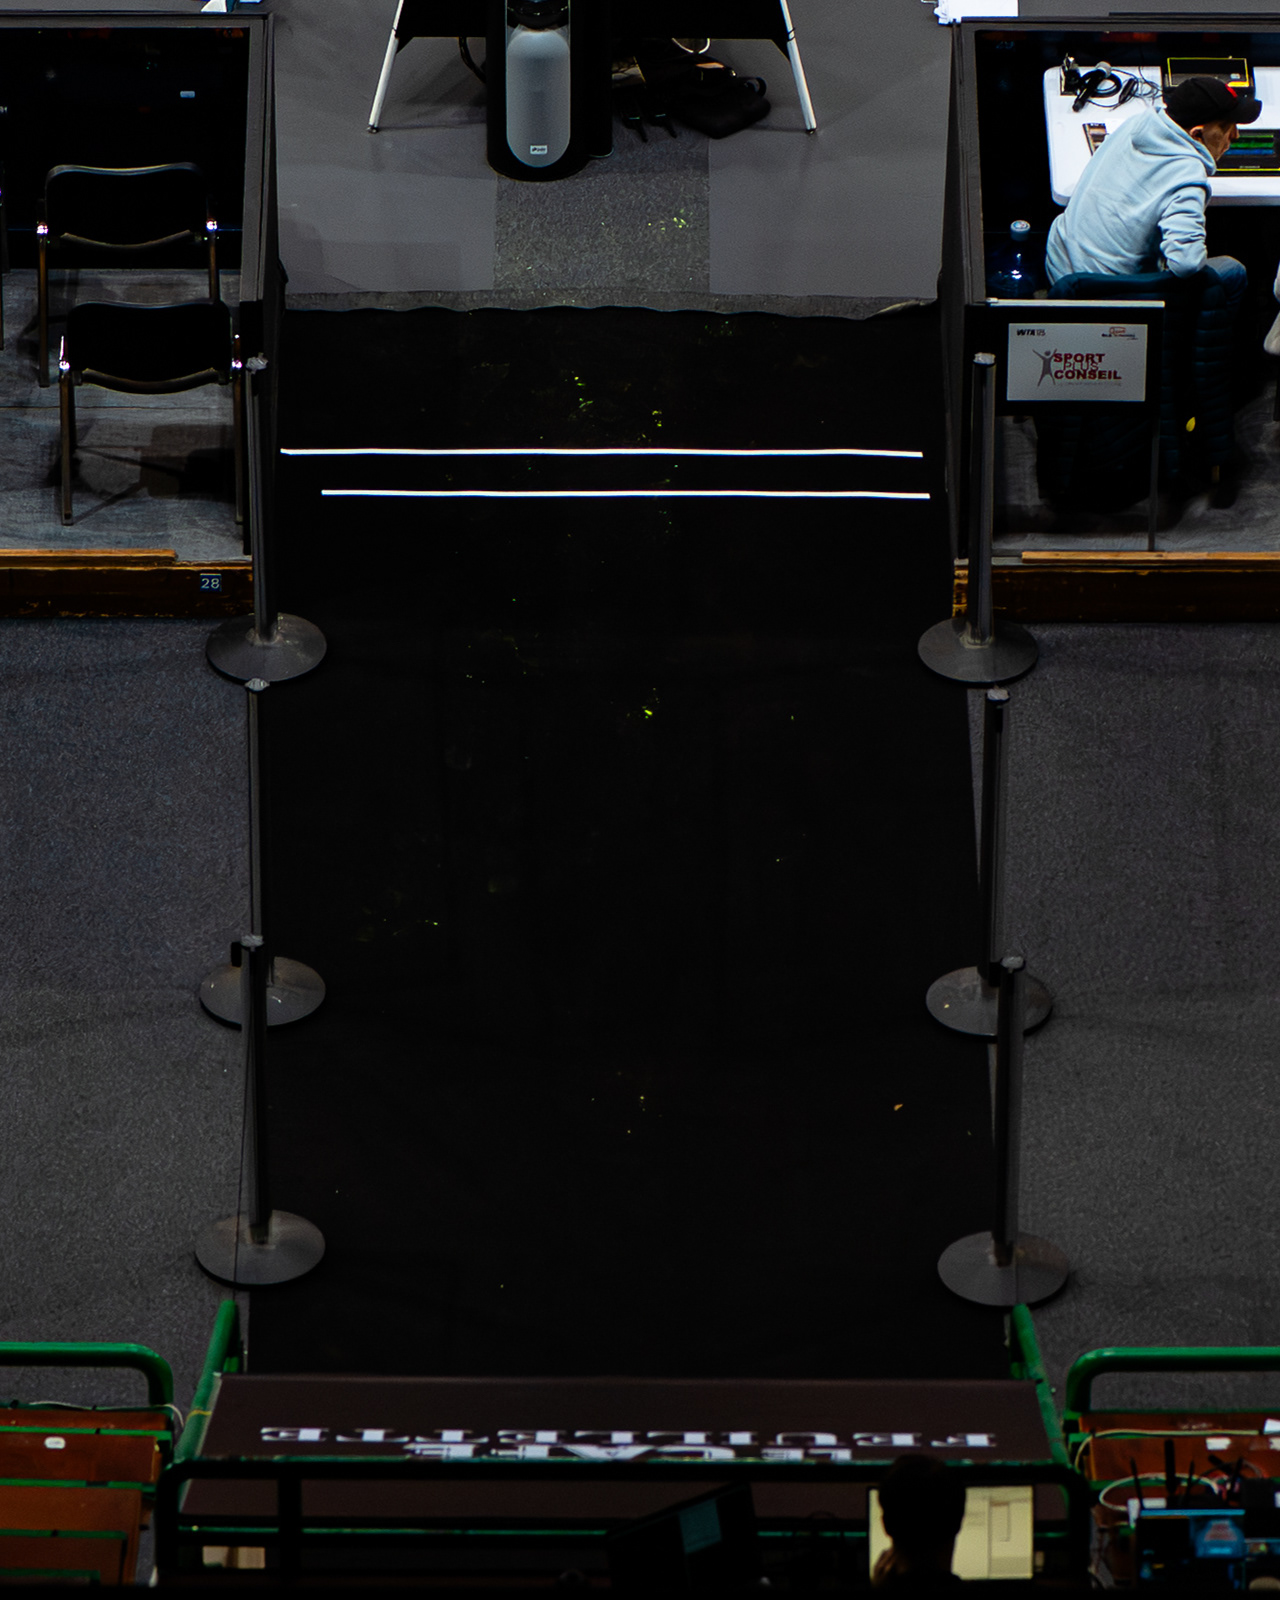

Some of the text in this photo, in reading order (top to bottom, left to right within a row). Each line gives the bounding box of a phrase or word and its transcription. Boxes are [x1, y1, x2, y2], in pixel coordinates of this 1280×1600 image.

[1053, 353, 1106, 363] SPORT
[1063, 361, 1099, 371] PLUS
[1054, 370, 1122, 380] CONSEIL
[201, 577, 220, 589] 28
[260, 1427, 997, 1447] FEUILLETTE
